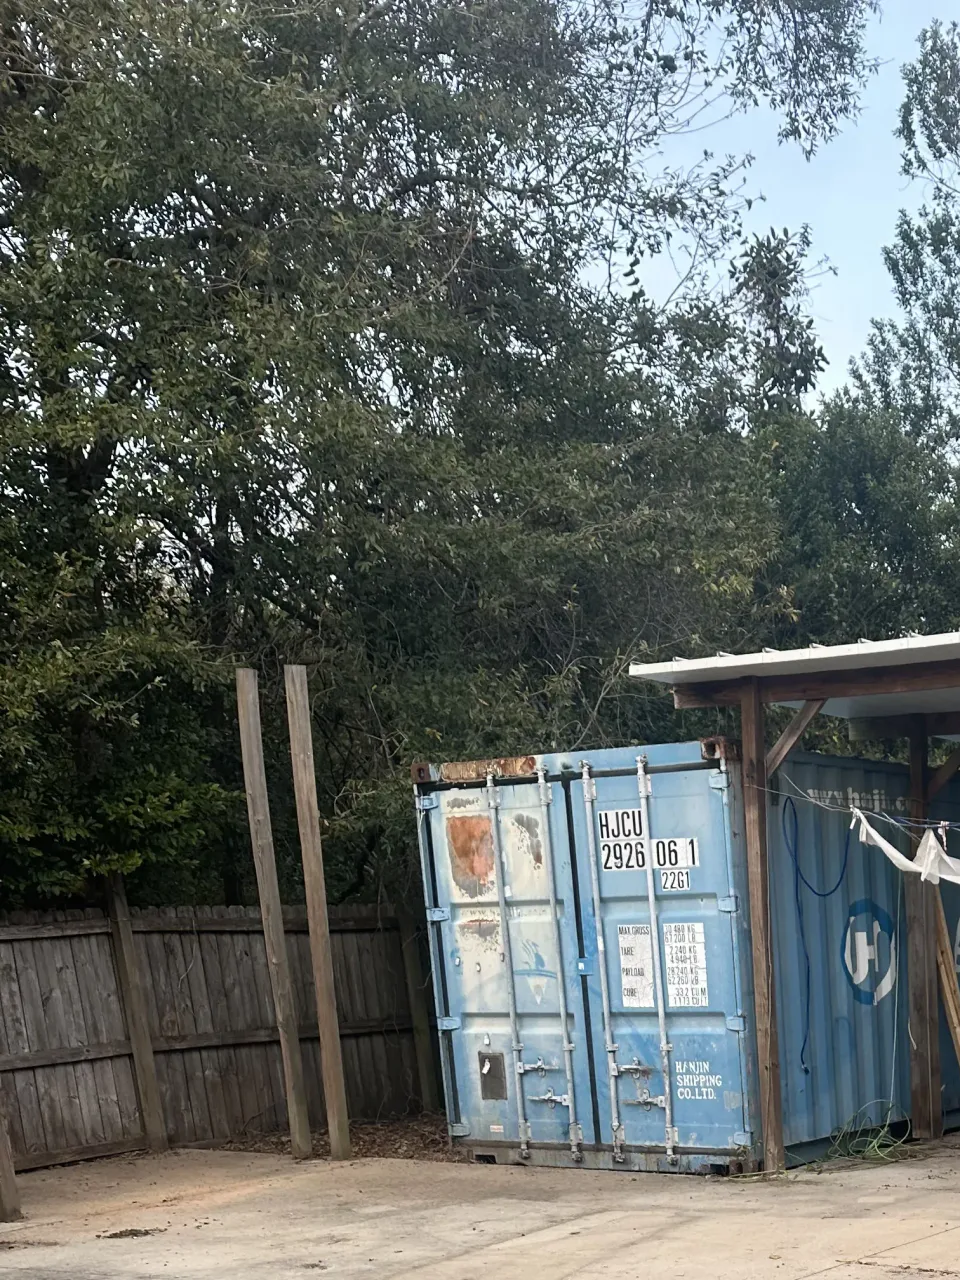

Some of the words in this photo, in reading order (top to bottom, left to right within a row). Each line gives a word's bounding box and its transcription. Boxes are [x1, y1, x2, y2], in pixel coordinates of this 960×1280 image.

[598, 810, 642, 839] HJCU
[602, 842, 645, 869] 2926
[656, 840, 678, 867] 06
[688, 838, 695, 866] 1
[661, 871, 690, 890] 22G1
[621, 946, 634, 956] TARE
[621, 967, 645, 976] PAYLOAD
[676, 1075, 722, 1087] SHIPPING
